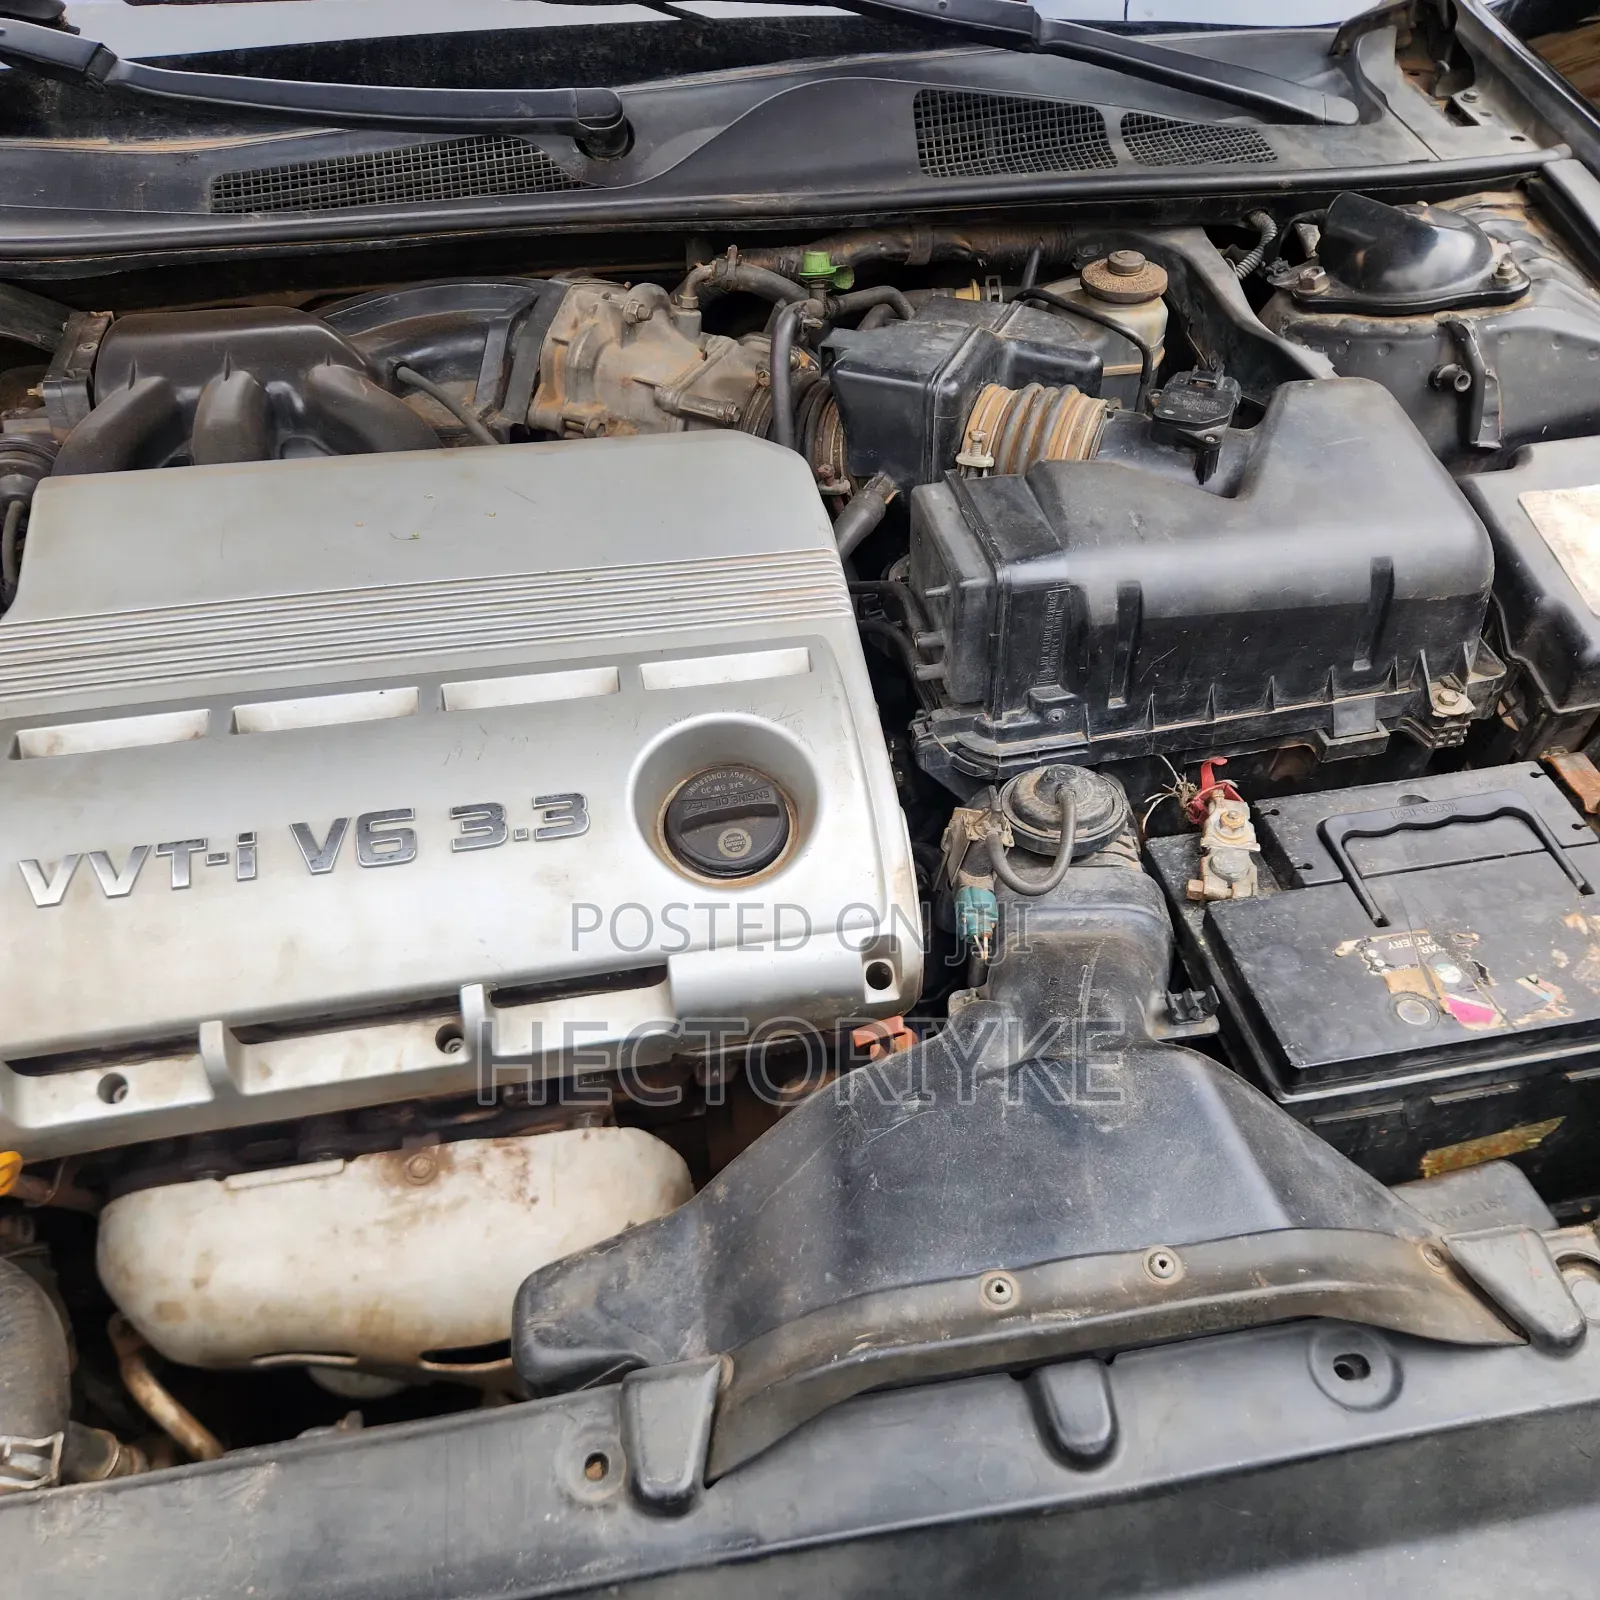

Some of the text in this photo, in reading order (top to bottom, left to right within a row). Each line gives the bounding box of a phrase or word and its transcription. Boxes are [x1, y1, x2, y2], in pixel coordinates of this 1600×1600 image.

[685, 771, 758, 797] ENERGY CONSERVING
[701, 781, 744, 794] SAE 5W-30
[715, 797, 730, 807] OIL
[733, 790, 770, 805] ENGINE
[18, 793, 590, 908] VVT-i V6 3.3
[725, 839, 746, 848] GASOLINE
